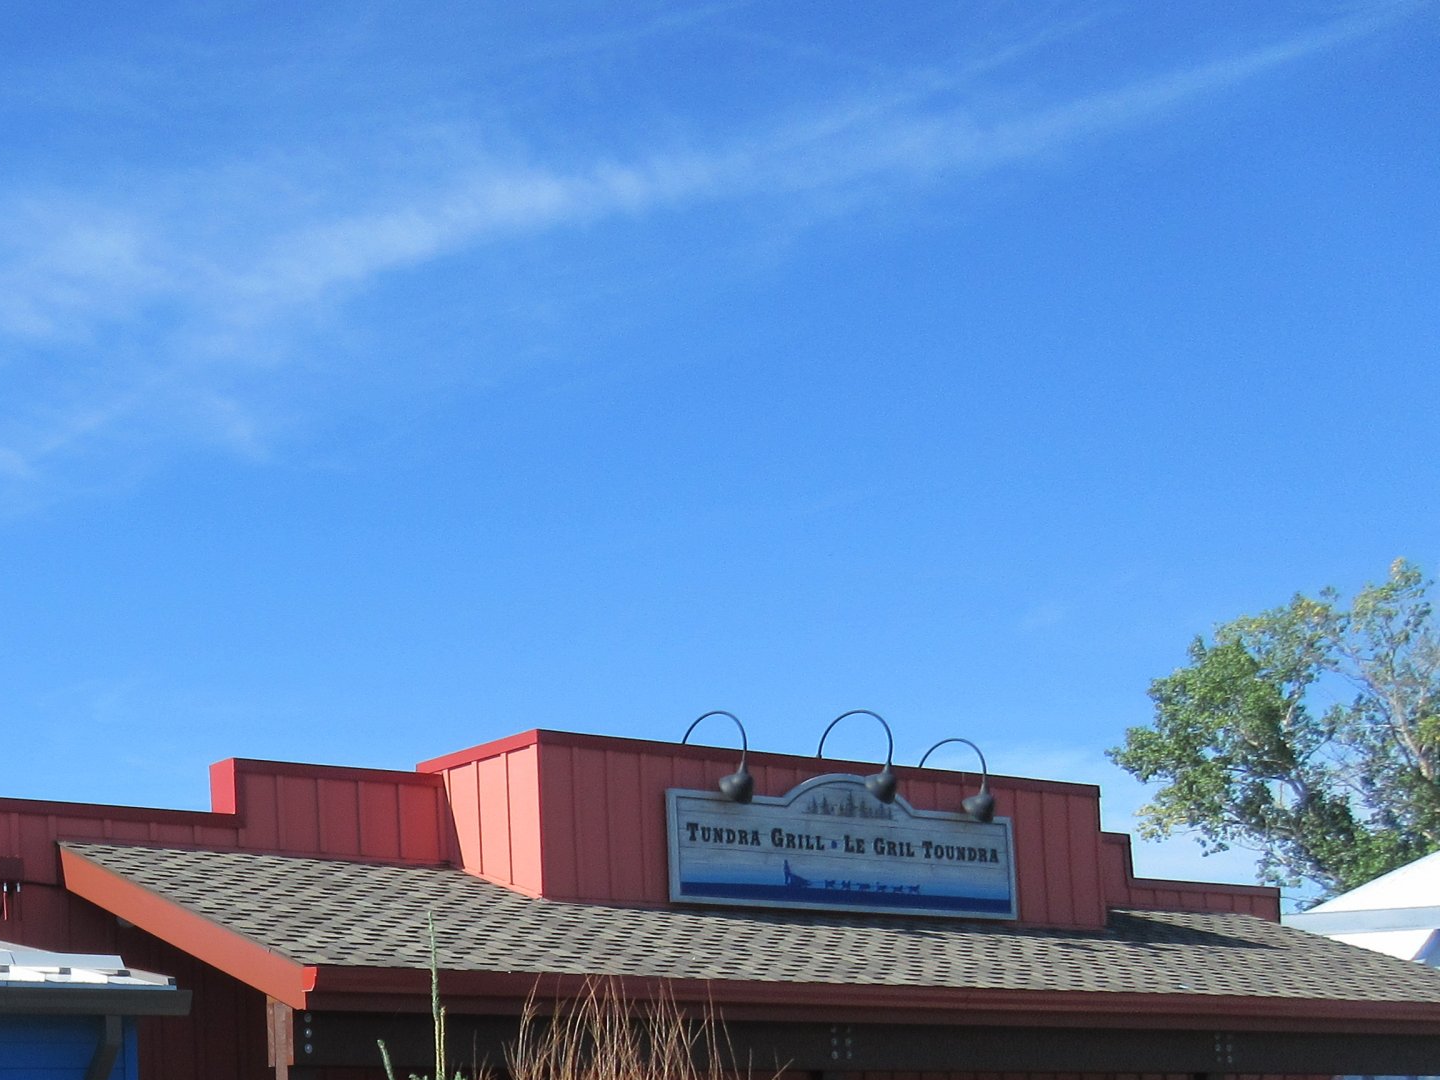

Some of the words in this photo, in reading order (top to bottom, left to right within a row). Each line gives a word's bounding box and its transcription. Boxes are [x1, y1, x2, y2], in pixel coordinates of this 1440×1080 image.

[686, 822, 761, 847] TUNDRA
[771, 828, 825, 851] GRILL
[843, 834, 865, 854] LE
[873, 837, 916, 858] GRIL
[921, 840, 1000, 863] TOUNDRA
